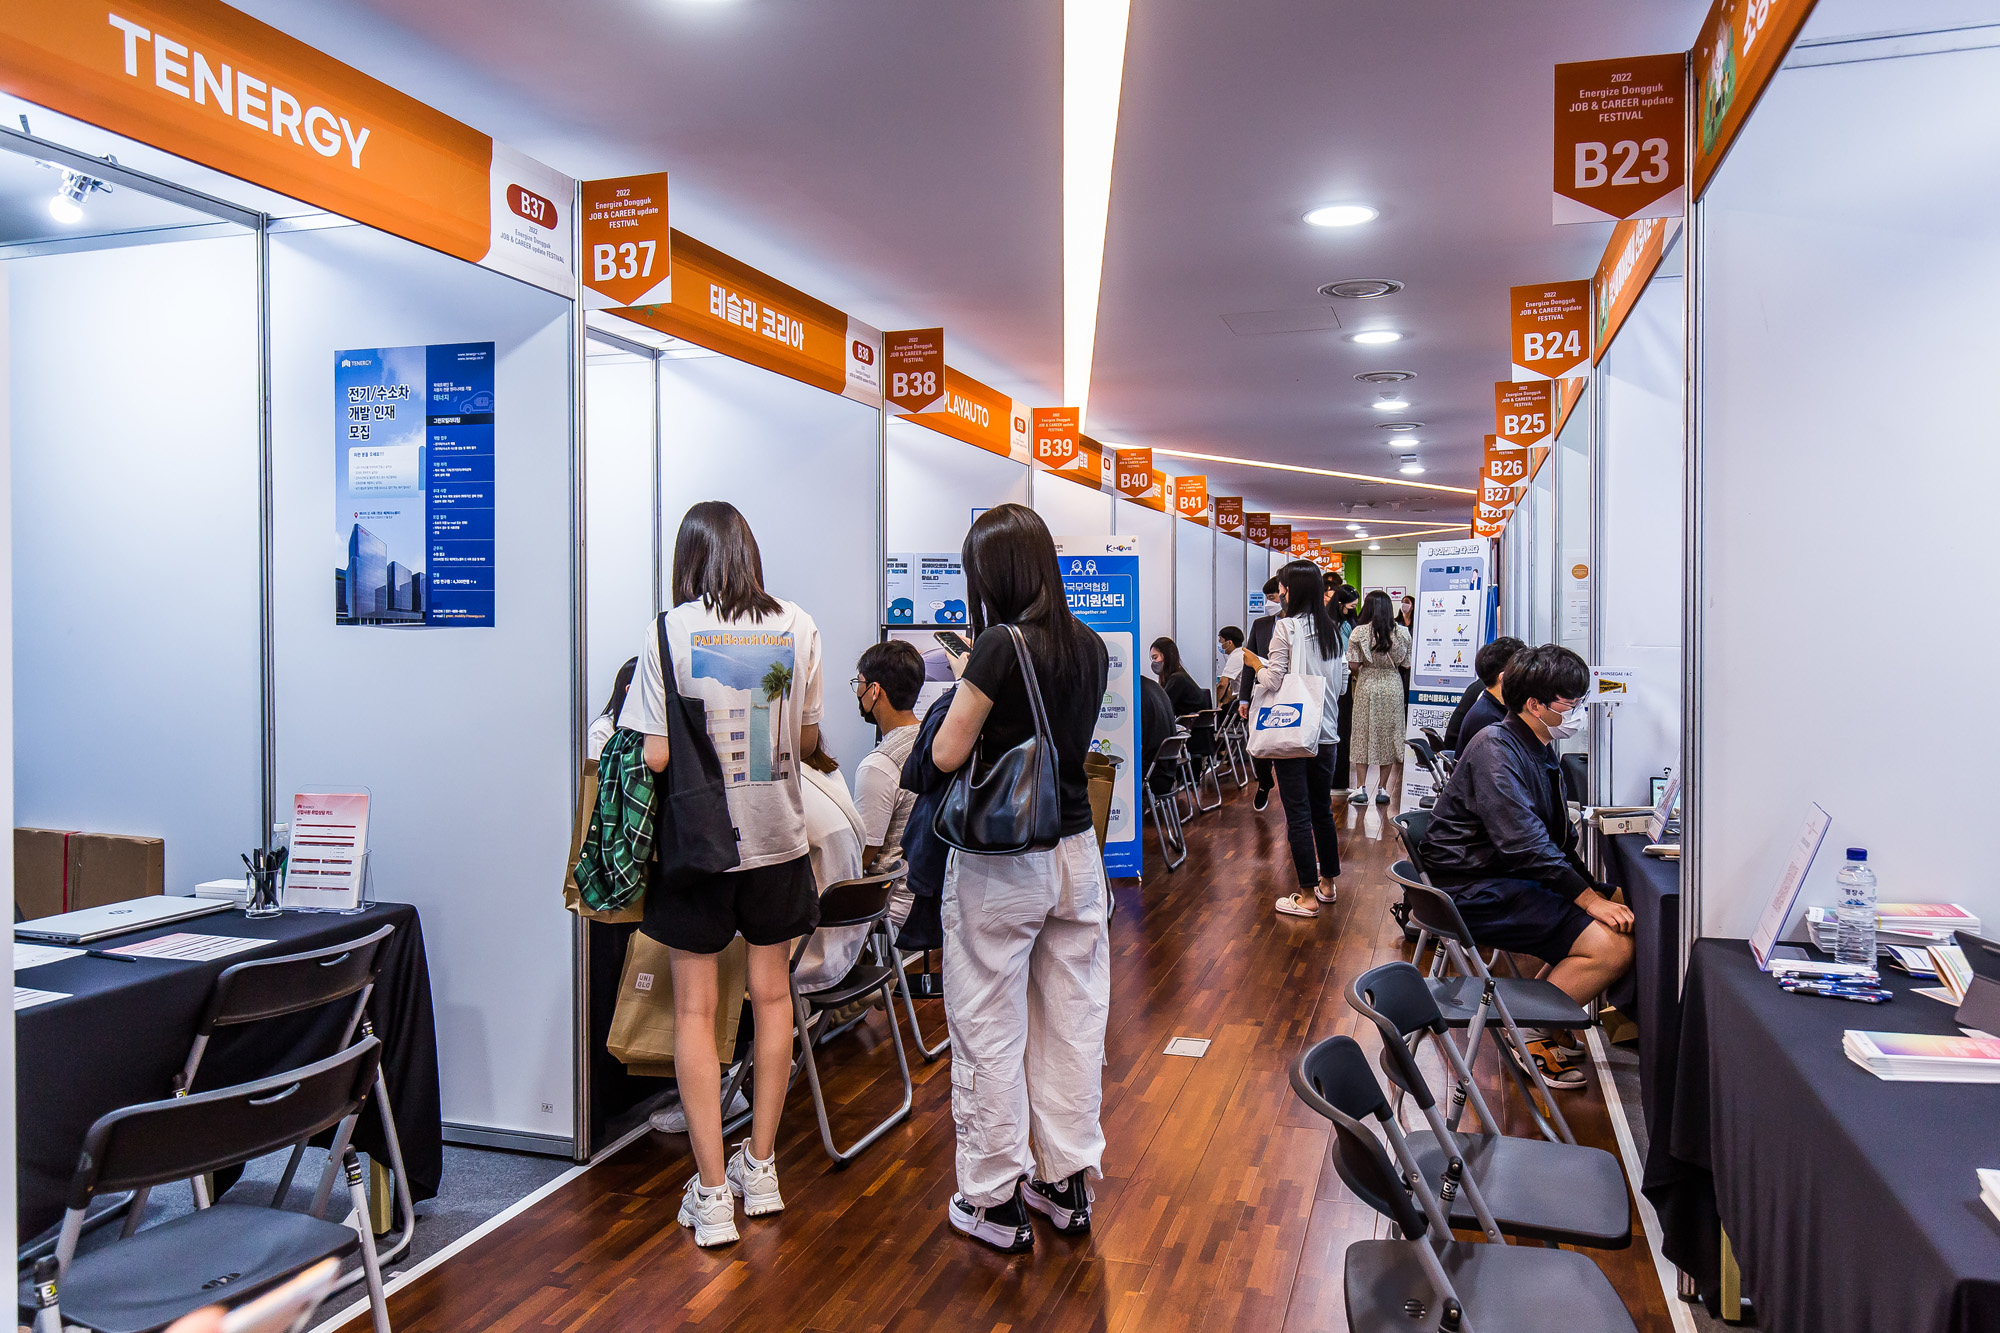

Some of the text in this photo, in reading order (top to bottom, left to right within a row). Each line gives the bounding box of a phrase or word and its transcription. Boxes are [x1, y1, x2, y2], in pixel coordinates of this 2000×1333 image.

[1611, 72, 1632, 82] 2022
[108, 12, 372, 169] TENERGY
[1579, 83, 1663, 99] Energize Dongguk
[1569, 95, 1674, 112] JOB & CAREER update
[1599, 110, 1643, 123] FESTIVAL
[1574, 138, 1669, 189] B23
[616, 188, 630, 197] 2022
[520, 190, 546, 221] B37
[595, 197, 652, 210] Energize Dongguk
[588, 207, 659, 221] JOB & CAREER update
[528, 225, 538, 235] 2022
[609, 218, 639, 229] FESTIVAL
[515, 228, 551, 250] Energize Dongguk
[500, 232, 510, 242] JOB
[514, 237, 532, 250] CAREER
[532, 244, 546, 257] update
[546, 250, 565, 264] FESTIVAL
[593, 240, 656, 282] B37
[1525, 297, 1576, 308] Energize Dongguk
[1562, 305, 1582, 313] update
[710, 283, 804, 351] 테슬라 코리아
[1537, 314, 1564, 322] FESTIVAL
[858, 343, 869, 361] B38
[1523, 329, 1581, 362] B24
[893, 371, 936, 397] B38
[349, 385, 410, 402] 전기/수소차
[349, 404, 395, 421] 개발 인재
[1504, 412, 1546, 436] B25
[349, 425, 370, 440] 모집
[1039, 438, 1073, 457] B39
[1490, 459, 1523, 477] B26
[1120, 472, 1148, 488] B40
[1484, 487, 1511, 501] B27
[1180, 496, 1202, 510] B41
[1219, 514, 1239, 525] B42
[1480, 509, 1503, 518] B28
[1249, 528, 1267, 538] B43
[1272, 537, 1289, 547] B44
[1291, 544, 1306, 552] B45
[724, 634, 759, 647] Beach
[637, 981, 650, 989] QLO
